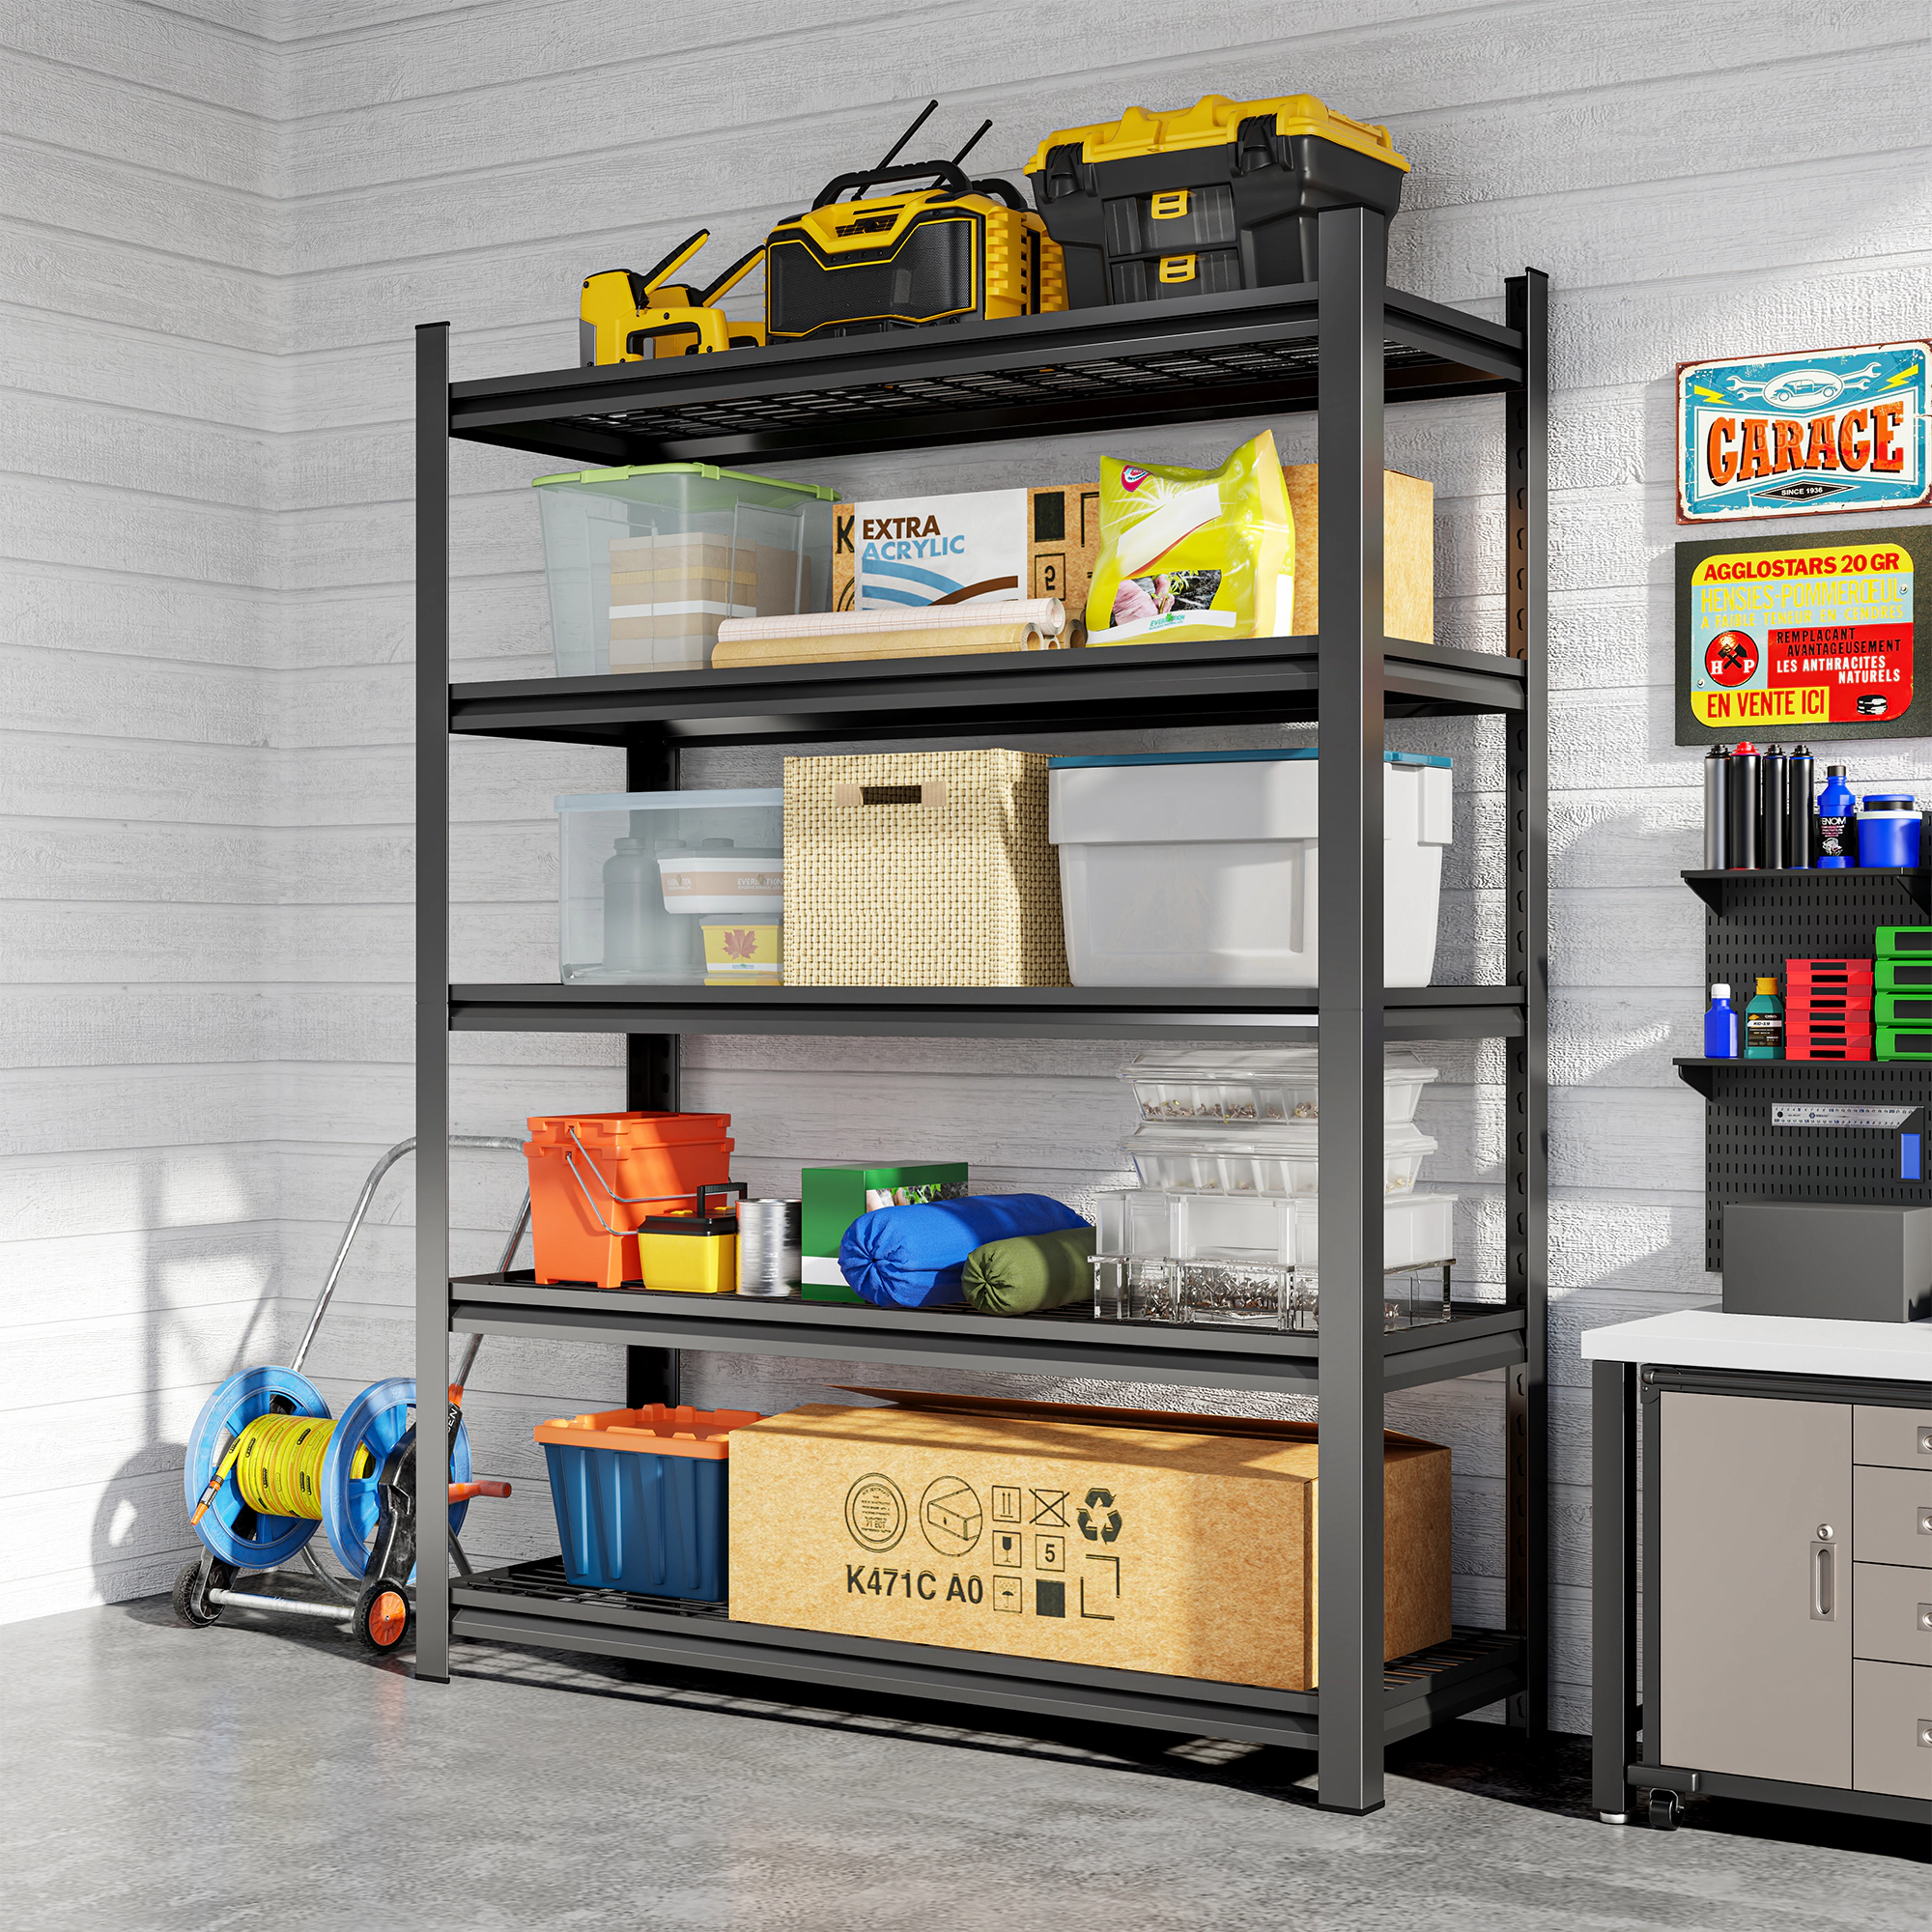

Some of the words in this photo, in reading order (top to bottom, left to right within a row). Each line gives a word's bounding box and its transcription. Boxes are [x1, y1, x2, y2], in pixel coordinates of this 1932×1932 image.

[1707, 401, 1904, 487] GARAGE
[1781, 488, 1804, 497] SINCE
[862, 514, 941, 540] EXTRA
[862, 534, 965, 561] ACRYLIC
[1703, 556, 1837, 582] AGGLOSTARS
[1840, 554, 1868, 573] 20
[1870, 553, 1900, 572] GR
[1701, 578, 1903, 613] HENSIES-POMMERŒUL
[1150, 612, 1185, 627] EVERTION
[1701, 615, 1710, 629] A
[1715, 612, 1755, 629] FAIBLE
[1763, 610, 1813, 626] TENEUR
[1820, 609, 1836, 623] EN
[1844, 605, 1904, 621] CENDRES
[1787, 639, 1901, 657] AVANTAGEUSEMENT
[1710, 661, 1723, 674] H
[1743, 659, 1755, 673] P
[1777, 659, 1798, 673] LES
[1803, 655, 1886, 671] ANTHRACITES
[1838, 668, 1900, 684] NATURELS
[1708, 693, 1731, 718] EN
[1737, 691, 1796, 717] VENTE
[1802, 689, 1825, 715] ICI
[737, 877, 783, 886] EVERTION
[1044, 1543, 1056, 1563] 5
[846, 1564, 937, 1601] K471C
